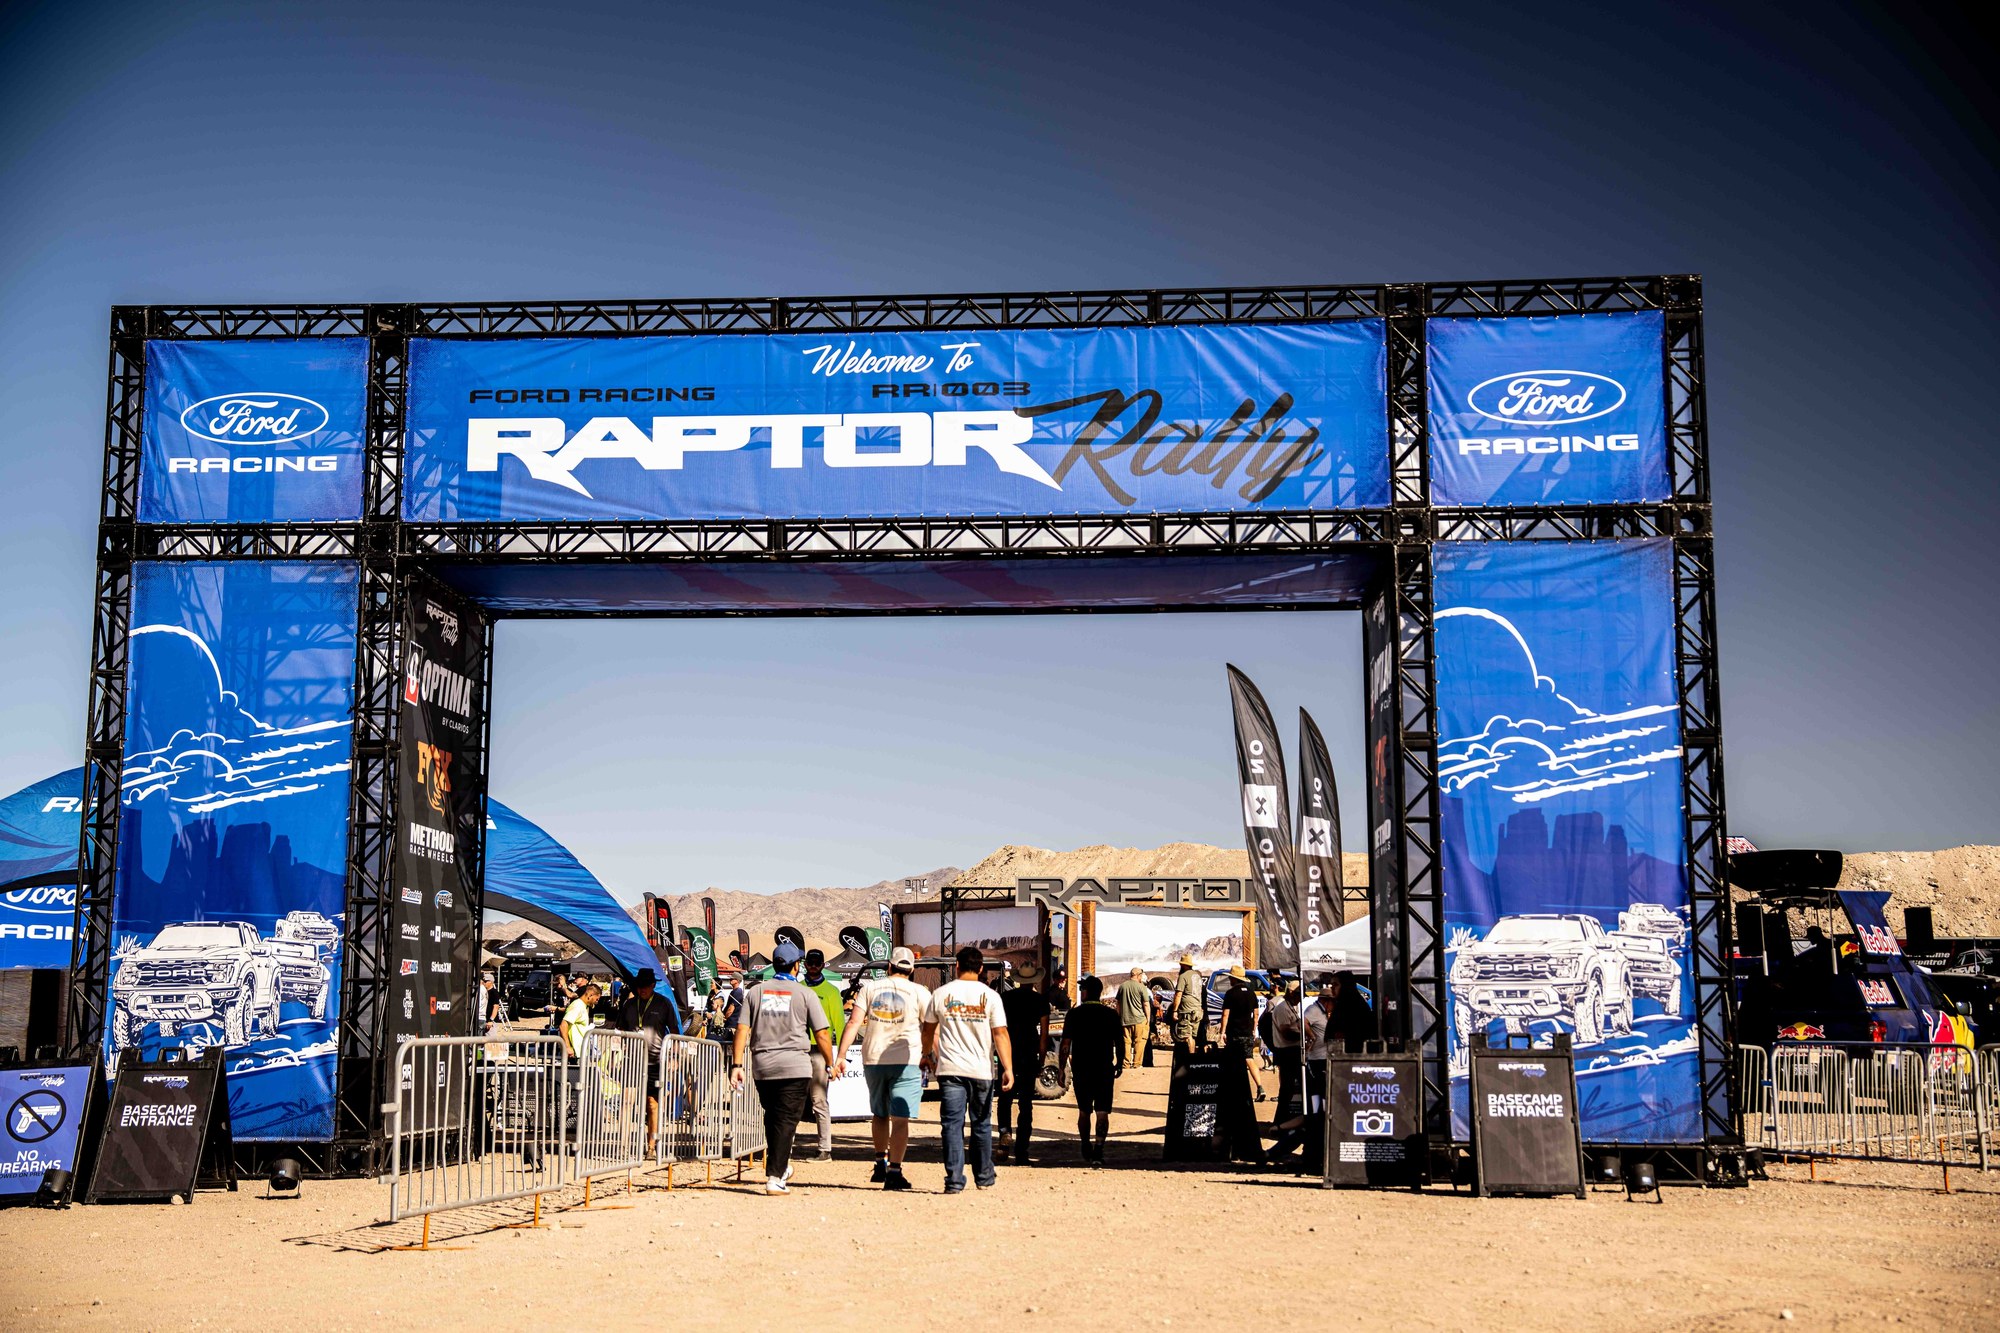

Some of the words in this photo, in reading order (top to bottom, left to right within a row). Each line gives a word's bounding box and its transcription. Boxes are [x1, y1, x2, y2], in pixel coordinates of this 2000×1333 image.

[802, 341, 937, 376] Welcome
[941, 341, 981, 372] To
[470, 388, 569, 404] FORD
[579, 386, 715, 403] RACING
[1498, 378, 1595, 415] Ford
[208, 400, 300, 437] Ford
[466, 410, 1063, 499] RAPTOR
[1013, 388, 1324, 507] Rally
[1458, 434, 1639, 455] RACING
[168, 455, 338, 474] RACING
[426, 603, 458, 629] RAPTOR
[421, 659, 473, 718] OPTIMA
[441, 716, 448, 726] BY
[449, 718, 469, 734] CLARIOS
[417, 740, 452, 794] FOX
[410, 822, 454, 854] METHOD
[409, 845, 425, 858] RACE
[427, 849, 454, 864] WHEELS
[0, 923, 90, 941] ACIN
[431, 961, 451, 973] SiriusXM
[1498, 1063, 1547, 1072] RAPTOR
[143, 1075, 189, 1084] RAPTOR
[1348, 1083, 1400, 1094] FILMING
[1350, 1093, 1397, 1104] NOTICE
[1487, 1093, 1563, 1106] BASECAMP
[122, 1104, 197, 1116] BASECAMP
[1488, 1105, 1564, 1118] ENTRANCE
[120, 1115, 194, 1127] ENTRANCE
[16, 1149, 39, 1161] NO
[0, 1159, 62, 1174] IREARMS
